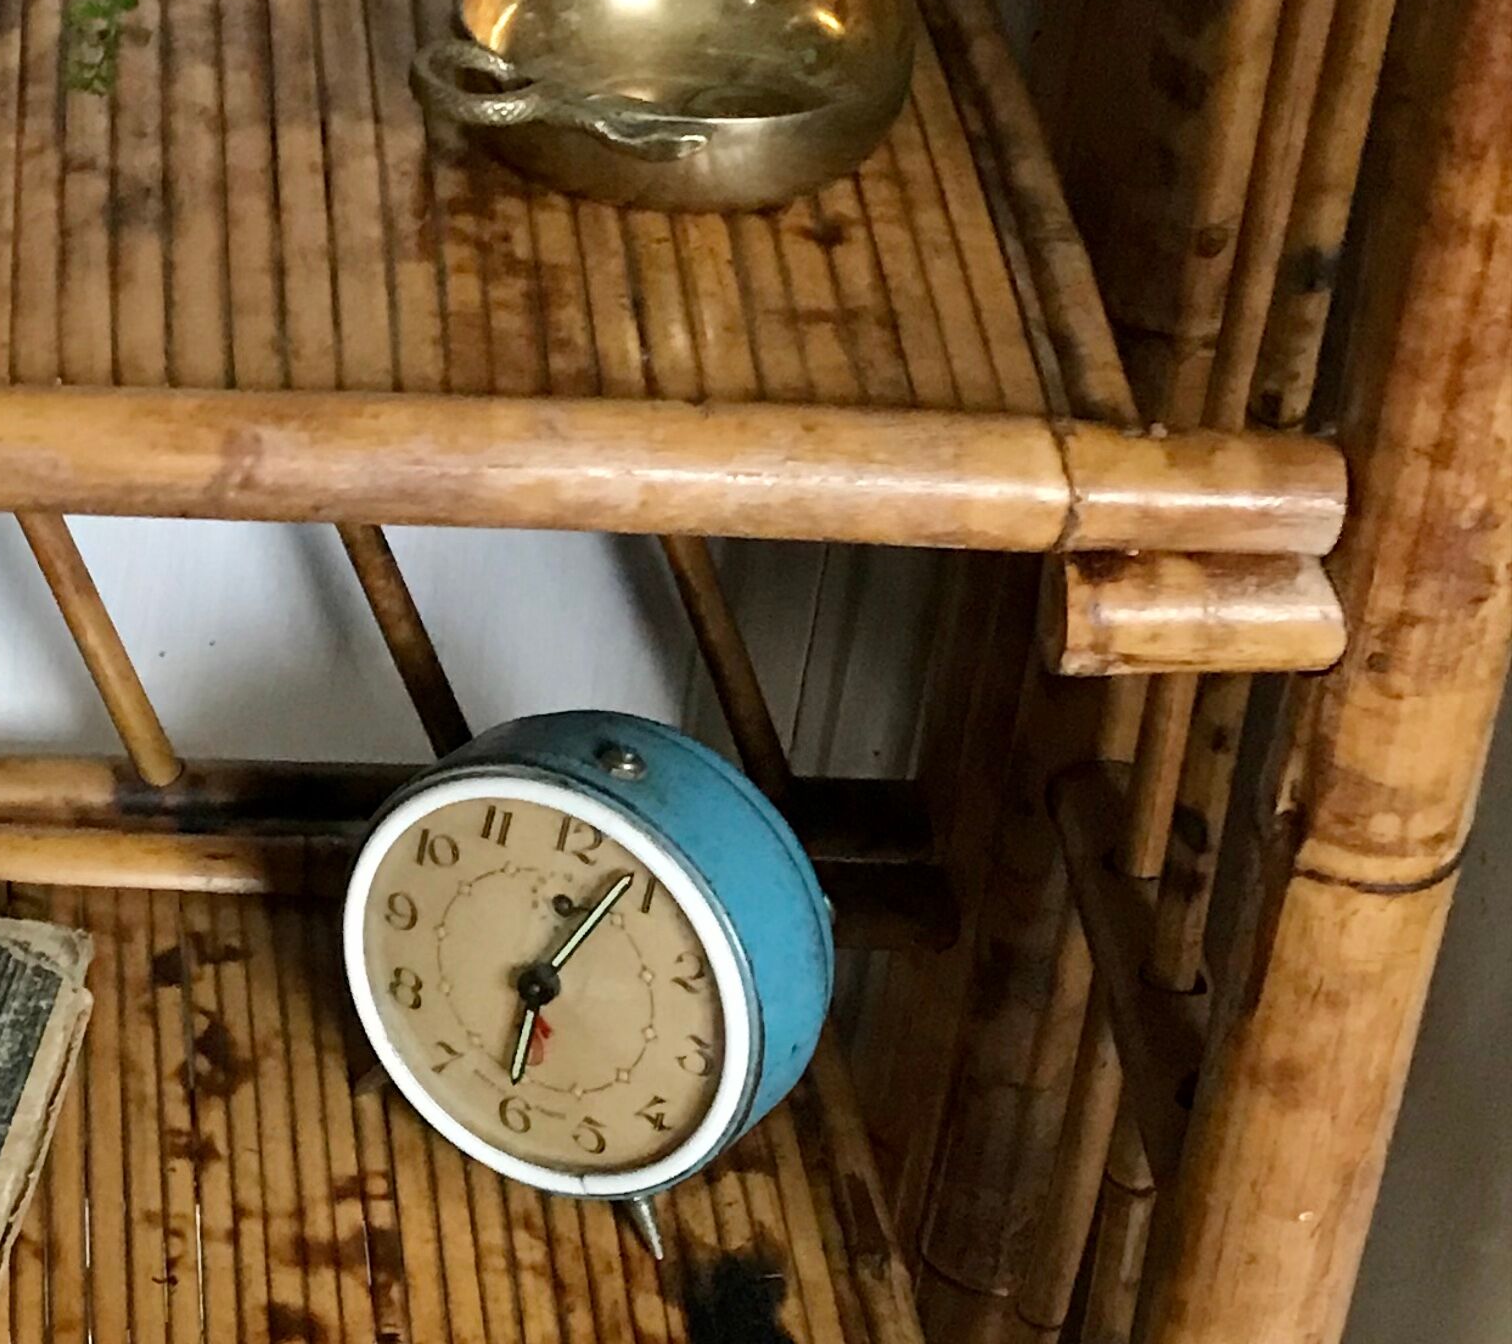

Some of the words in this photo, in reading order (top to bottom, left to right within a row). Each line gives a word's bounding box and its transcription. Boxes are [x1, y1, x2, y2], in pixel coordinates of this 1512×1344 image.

[480, 804, 513, 846] 11
[555, 813, 604, 865] 12
[415, 827, 460, 869] 10
[384, 891, 419, 931] 9
[641, 875, 658, 914] 1
[388, 967, 423, 1011] 8
[670, 950, 706, 994] 2
[429, 1041, 464, 1074] 7
[677, 1034, 713, 1078] 3
[497, 1095, 533, 1135] 6
[633, 1095, 673, 1134] 4
[571, 1115, 609, 1156] 5
